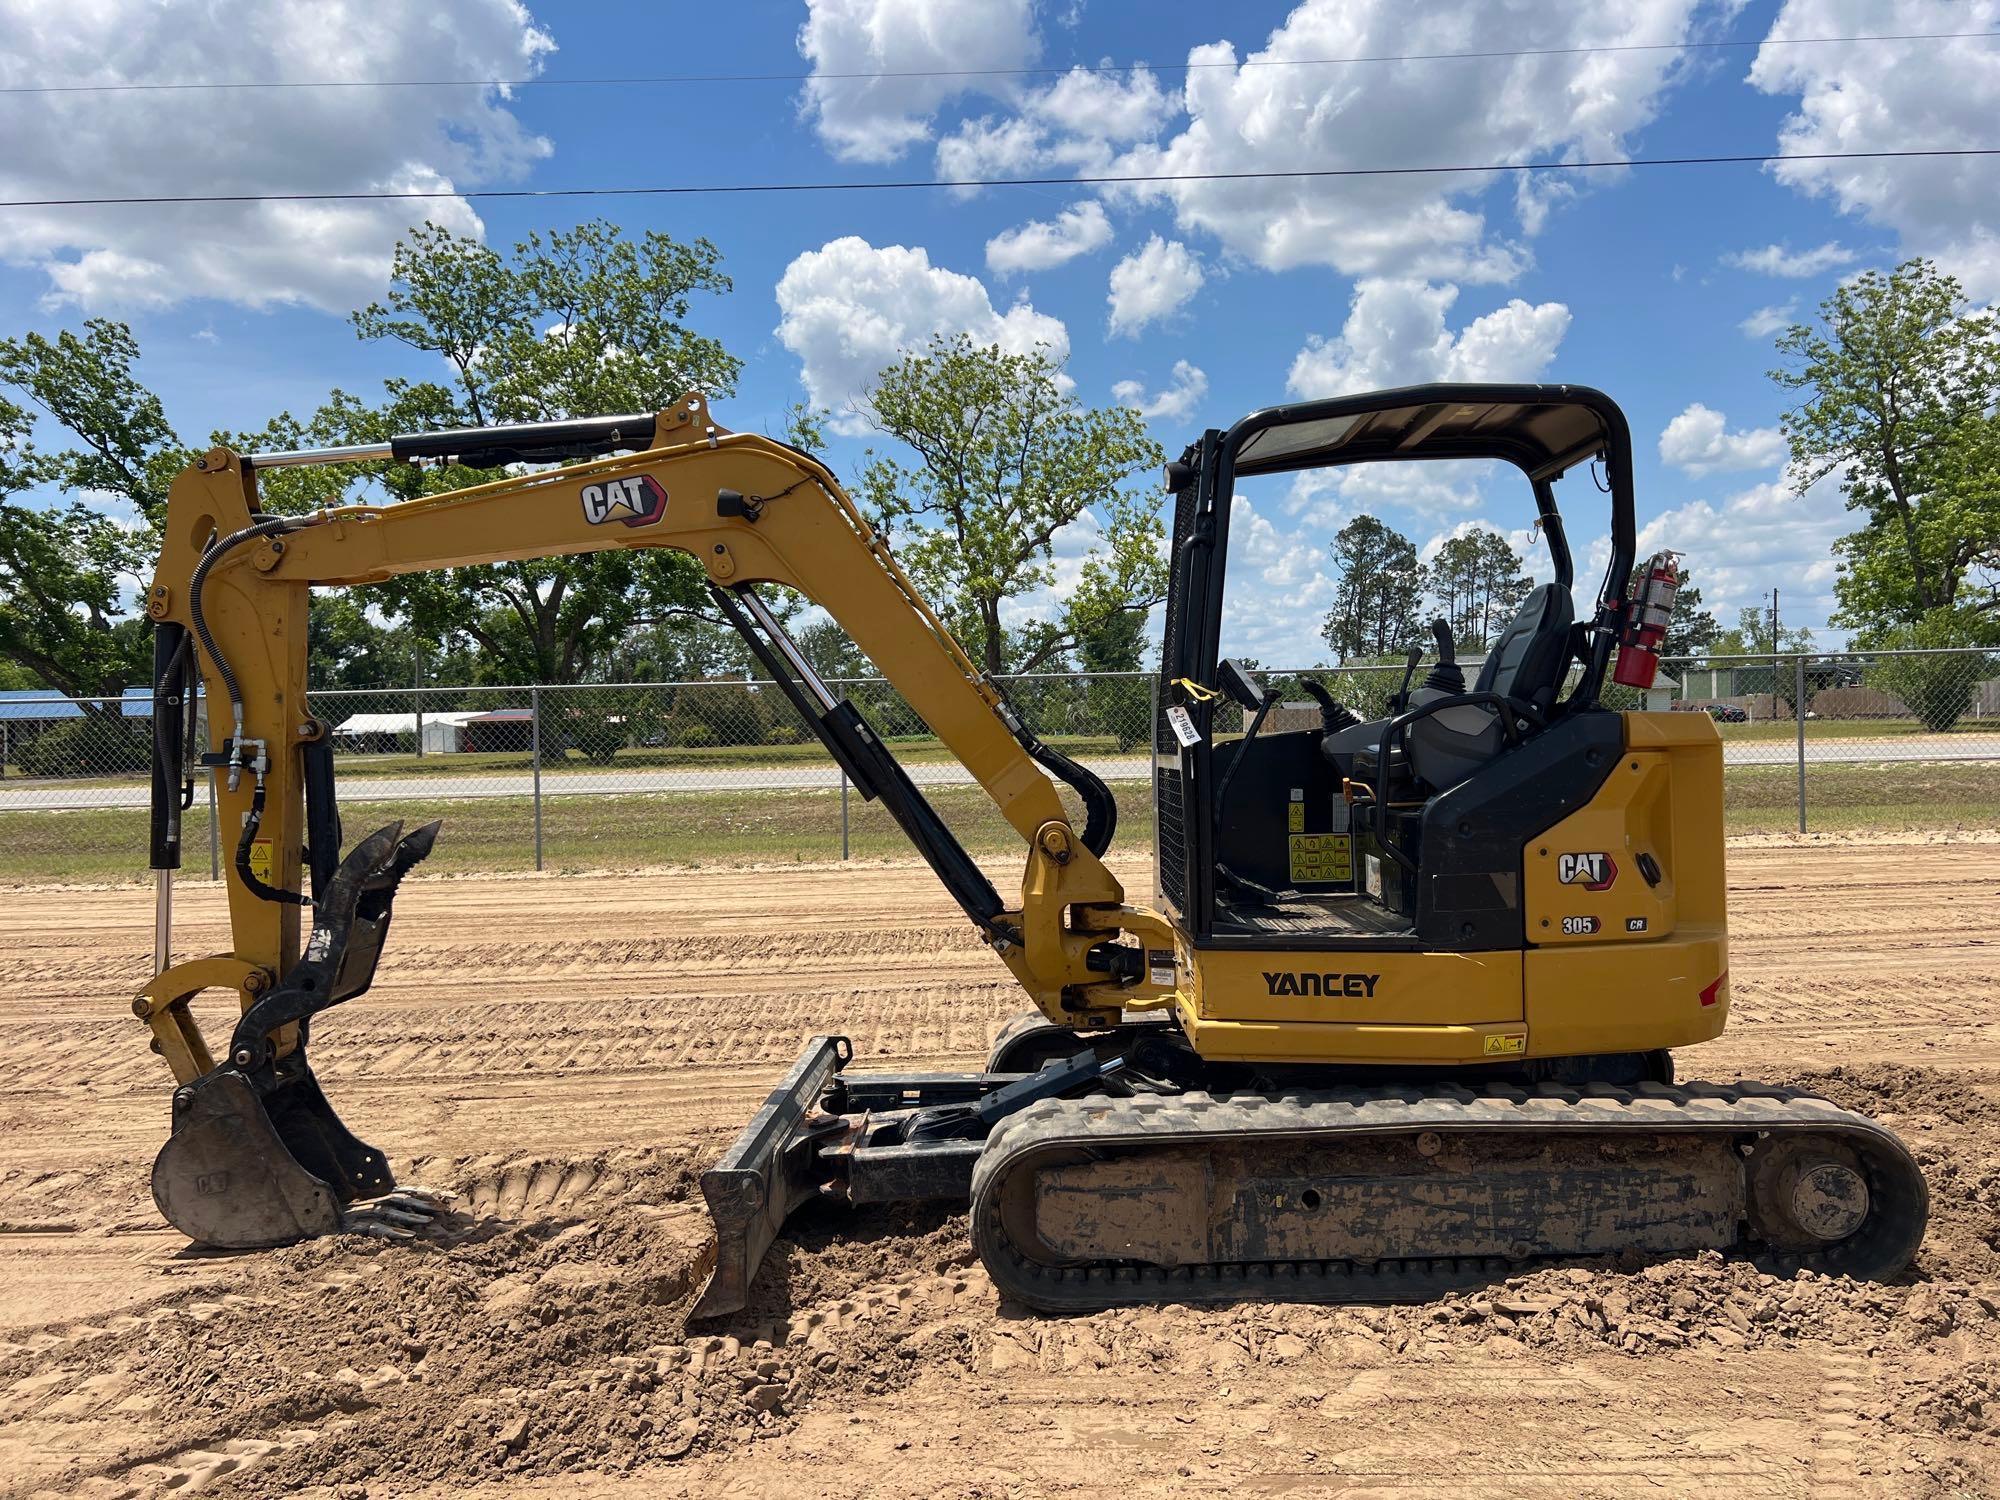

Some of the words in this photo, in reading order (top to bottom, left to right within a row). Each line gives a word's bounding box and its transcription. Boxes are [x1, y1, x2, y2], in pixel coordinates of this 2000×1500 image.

[582, 476, 645, 524] CAT
[1175, 713, 1196, 740] 219628
[1559, 854, 1604, 884] CAT
[1562, 917, 1592, 934] 305
[1629, 919, 1644, 930] CR
[1261, 972, 1380, 997] YANCEY
